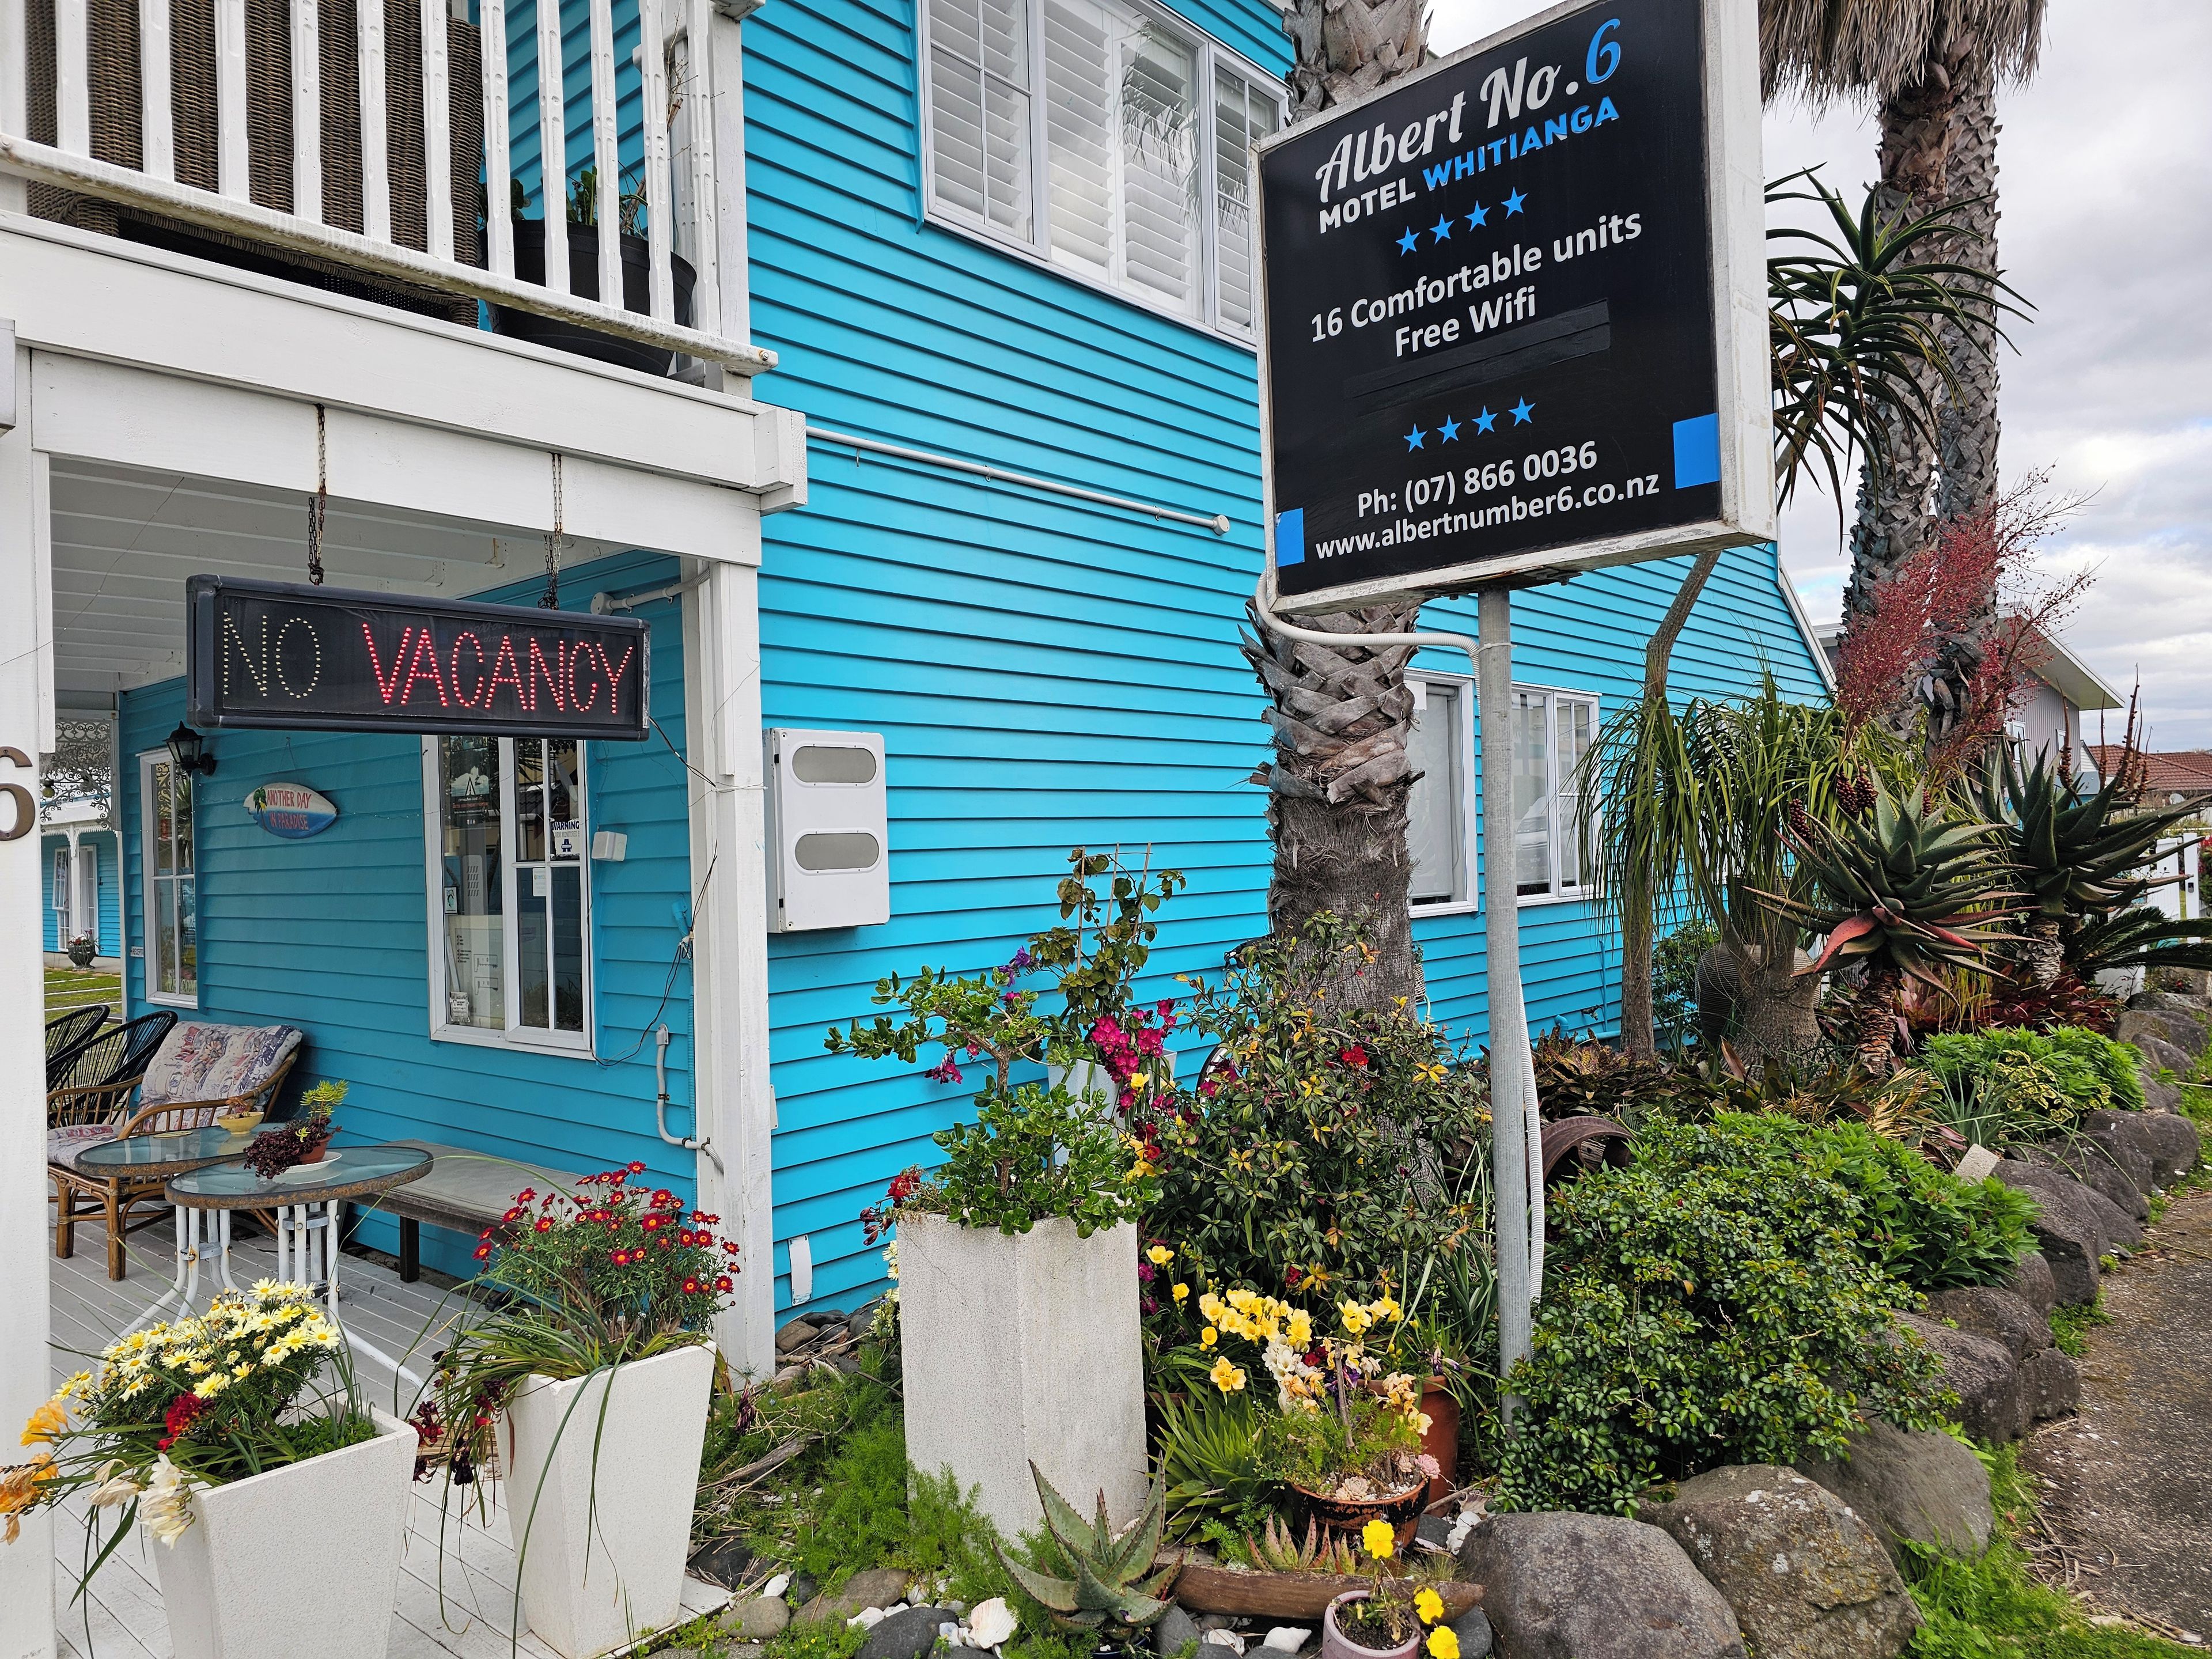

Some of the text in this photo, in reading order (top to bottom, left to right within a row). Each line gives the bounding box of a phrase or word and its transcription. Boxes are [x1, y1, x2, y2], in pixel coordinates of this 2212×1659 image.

[1315, 91, 1466, 203] Albert
[1320, 96, 1619, 234] MOTEL WHITIANGA
[1312, 214, 1641, 342] 16 Comfortable units
[1396, 286, 1535, 357] Free Wifi
[1316, 475, 1659, 559] www.albertnumber6.co.nz
[1358, 441, 1597, 517] Ph: (07) 866 0036
[224, 612, 632, 716] NO VACANCY
[268, 790, 312, 809] ANOTHER DAY
[270, 813, 309, 830] IN PARADISE
[551, 821, 579, 830] WARNING
